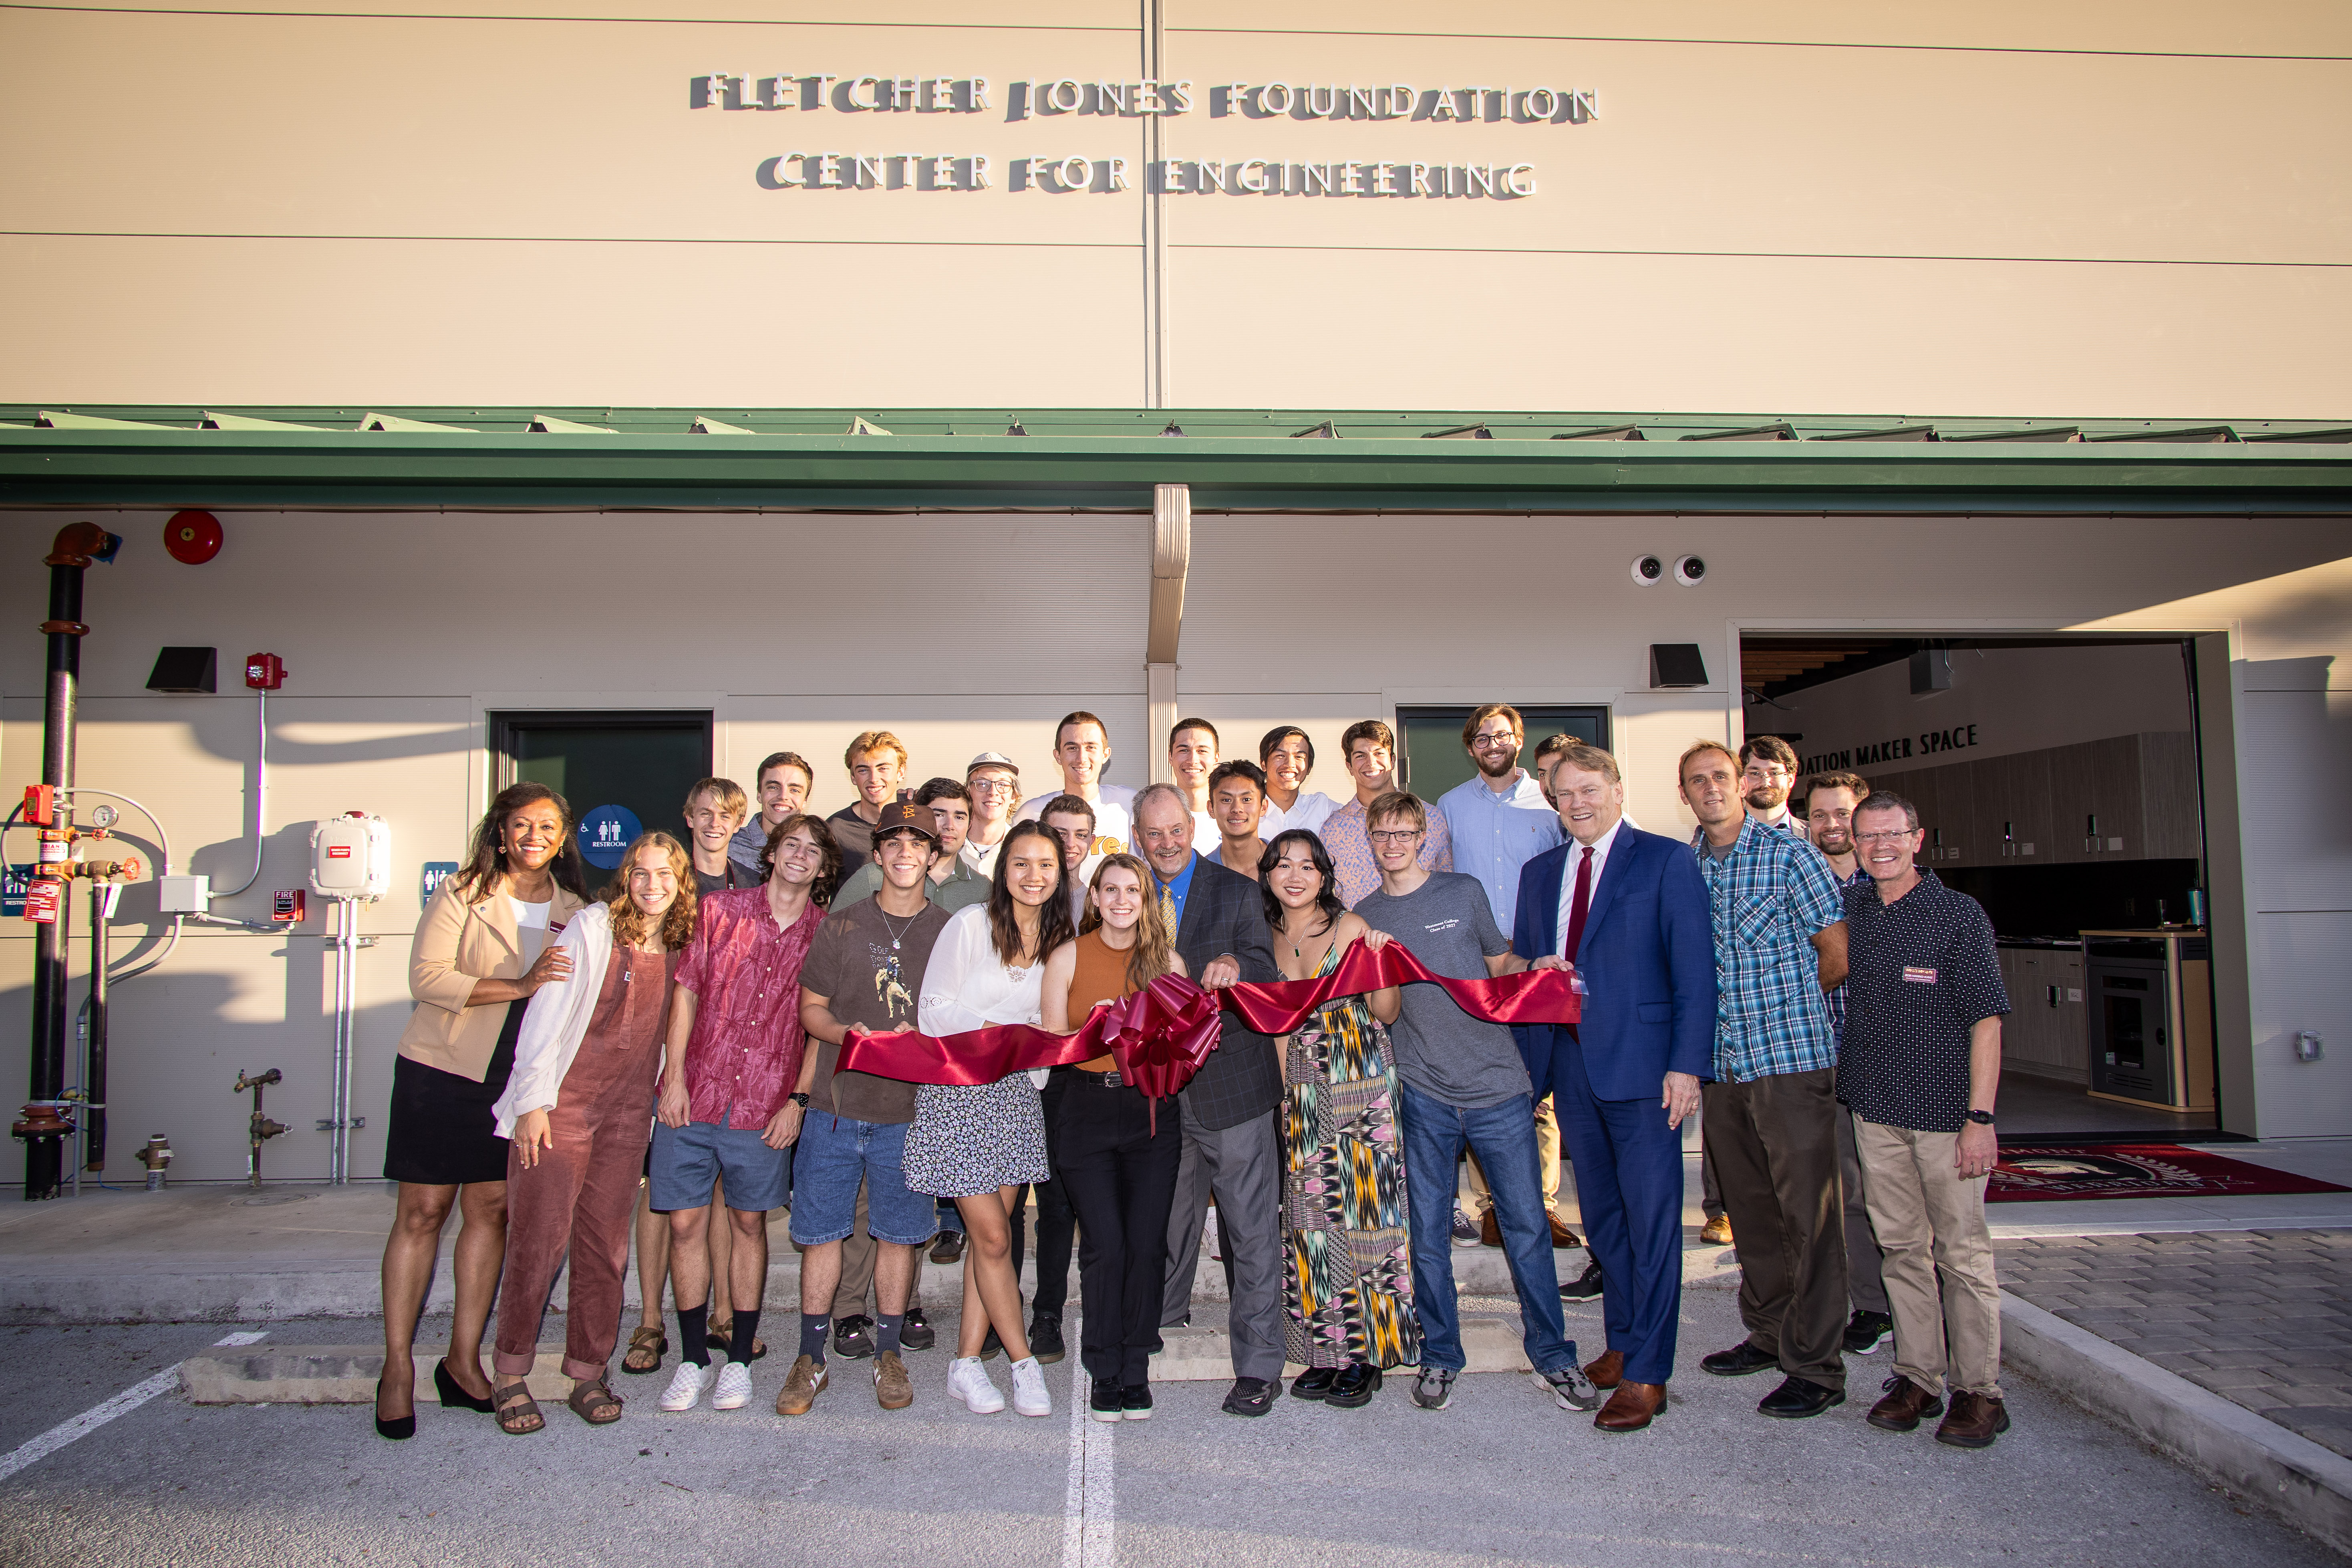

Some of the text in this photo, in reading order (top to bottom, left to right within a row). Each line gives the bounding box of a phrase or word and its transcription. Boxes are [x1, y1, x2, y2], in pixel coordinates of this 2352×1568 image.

[709, 71, 1599, 120] FLETCHER JONES FOUNDATION
[778, 151, 1536, 196] CENTER FOR ENGINEERING
[1797, 724, 1978, 776] DATION MAKER SPACE
[2044, 1181, 2205, 1191] WARRIORS
